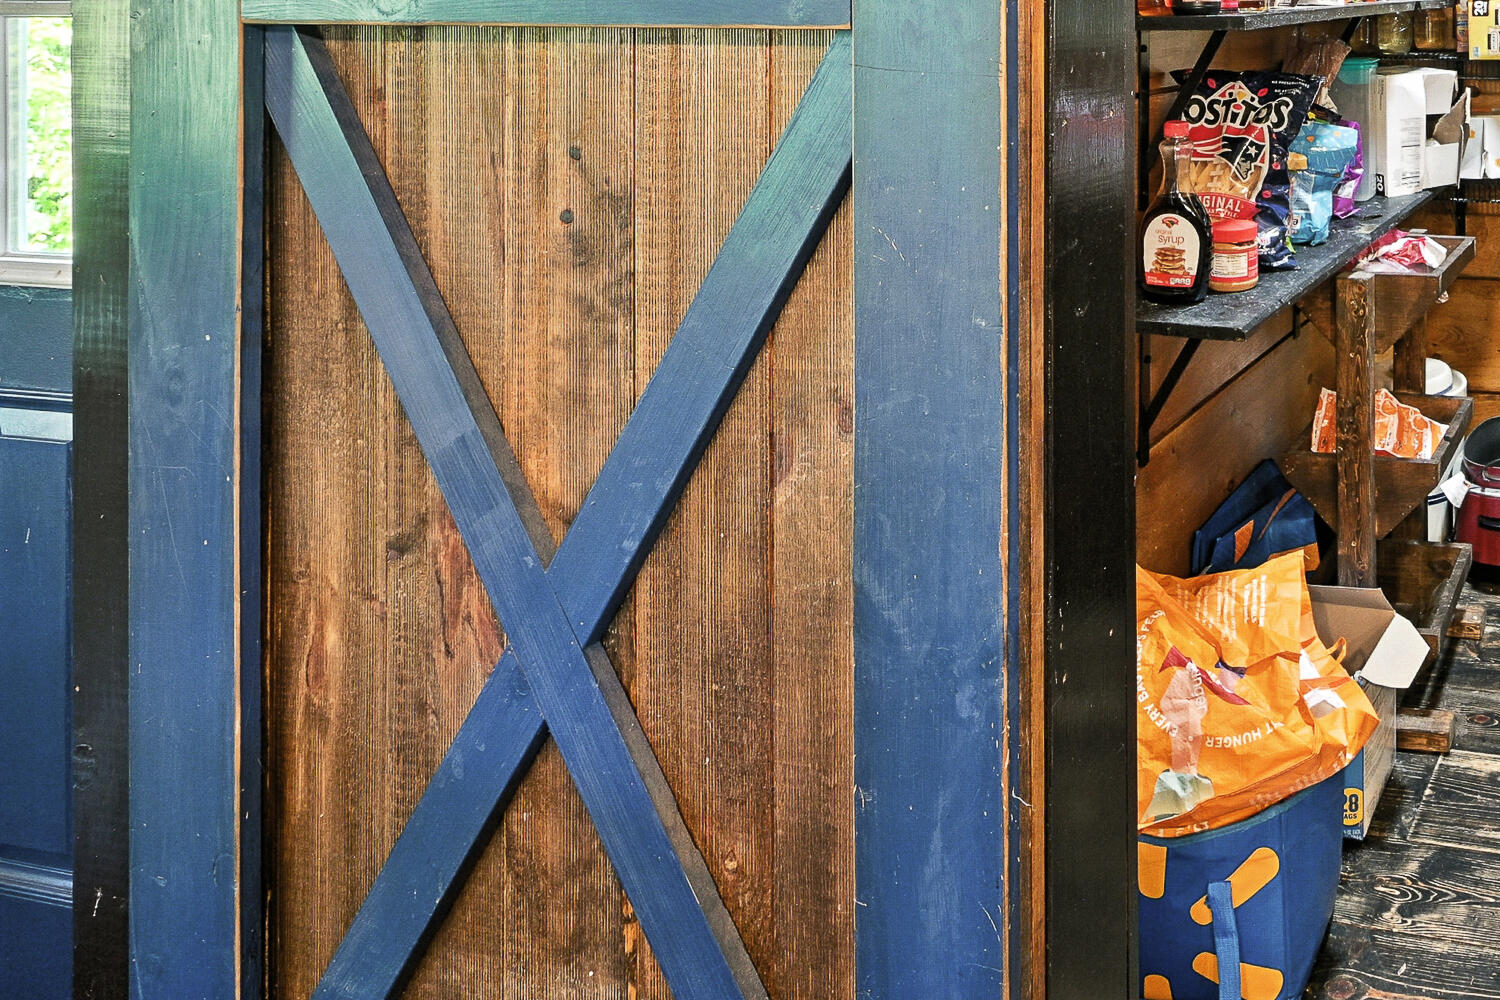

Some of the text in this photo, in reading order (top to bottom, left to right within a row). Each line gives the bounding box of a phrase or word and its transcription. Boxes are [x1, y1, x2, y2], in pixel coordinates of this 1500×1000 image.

[1474, 0, 1484, 16] 20
[1158, 234, 1184, 245] syrup
[1143, 703, 1178, 738] EVERY
[1205, 727, 1262, 748] HUNGER
